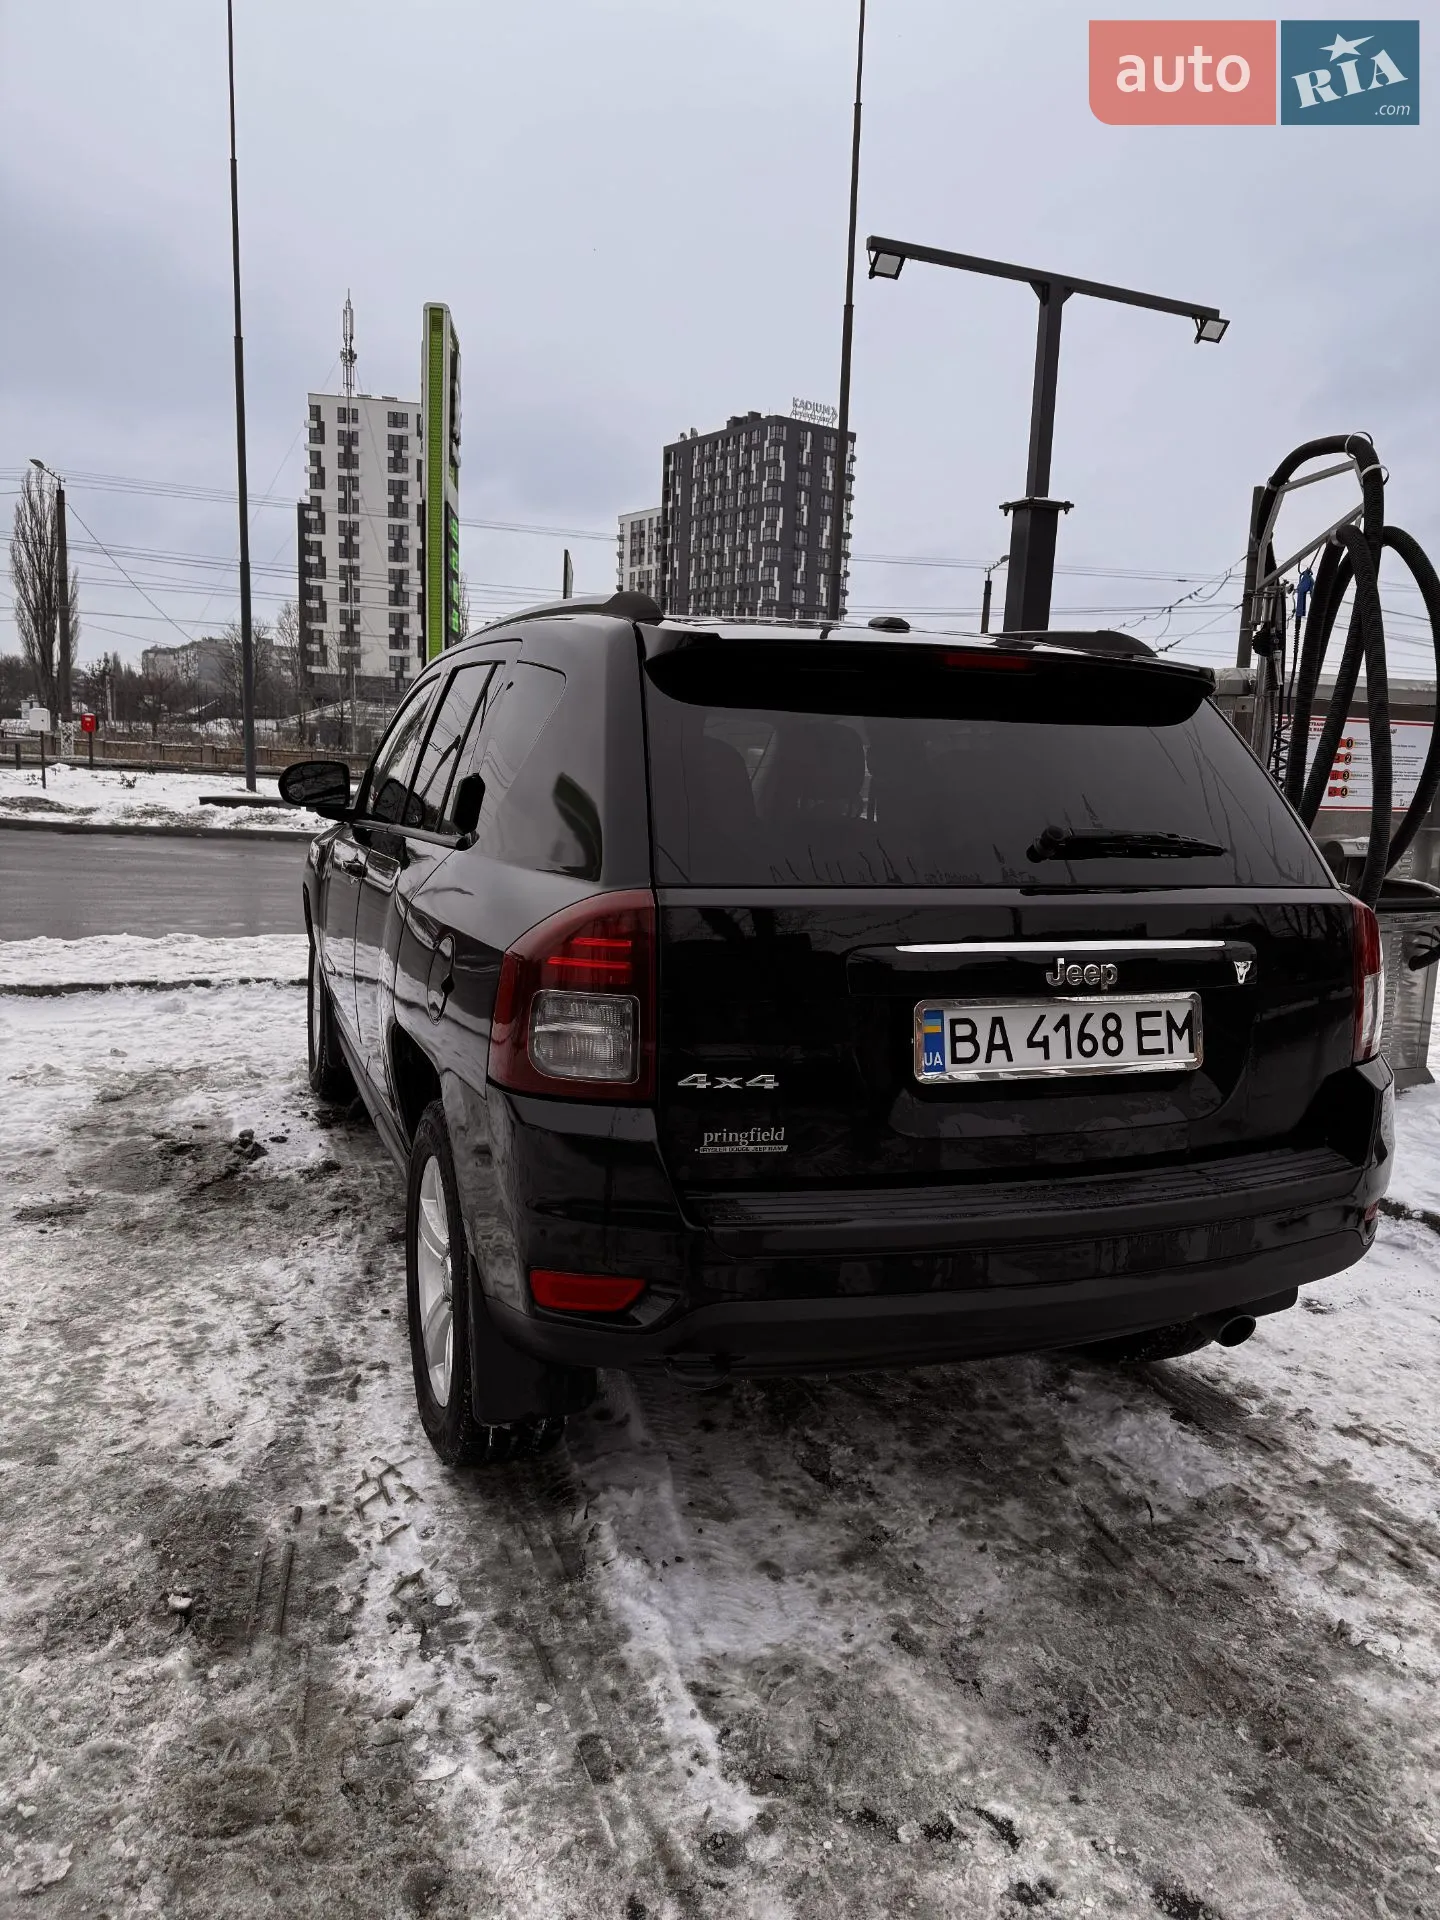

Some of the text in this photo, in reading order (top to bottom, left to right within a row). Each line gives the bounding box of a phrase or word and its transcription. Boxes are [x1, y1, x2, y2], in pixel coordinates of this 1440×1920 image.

[1046, 958, 1119, 991] Jeep
[950, 1008, 1195, 1065] BA 4168 EM
[924, 1051, 944, 1067] UA
[677, 1073, 780, 1089] 4x4
[702, 1127, 786, 1147] pringfield
